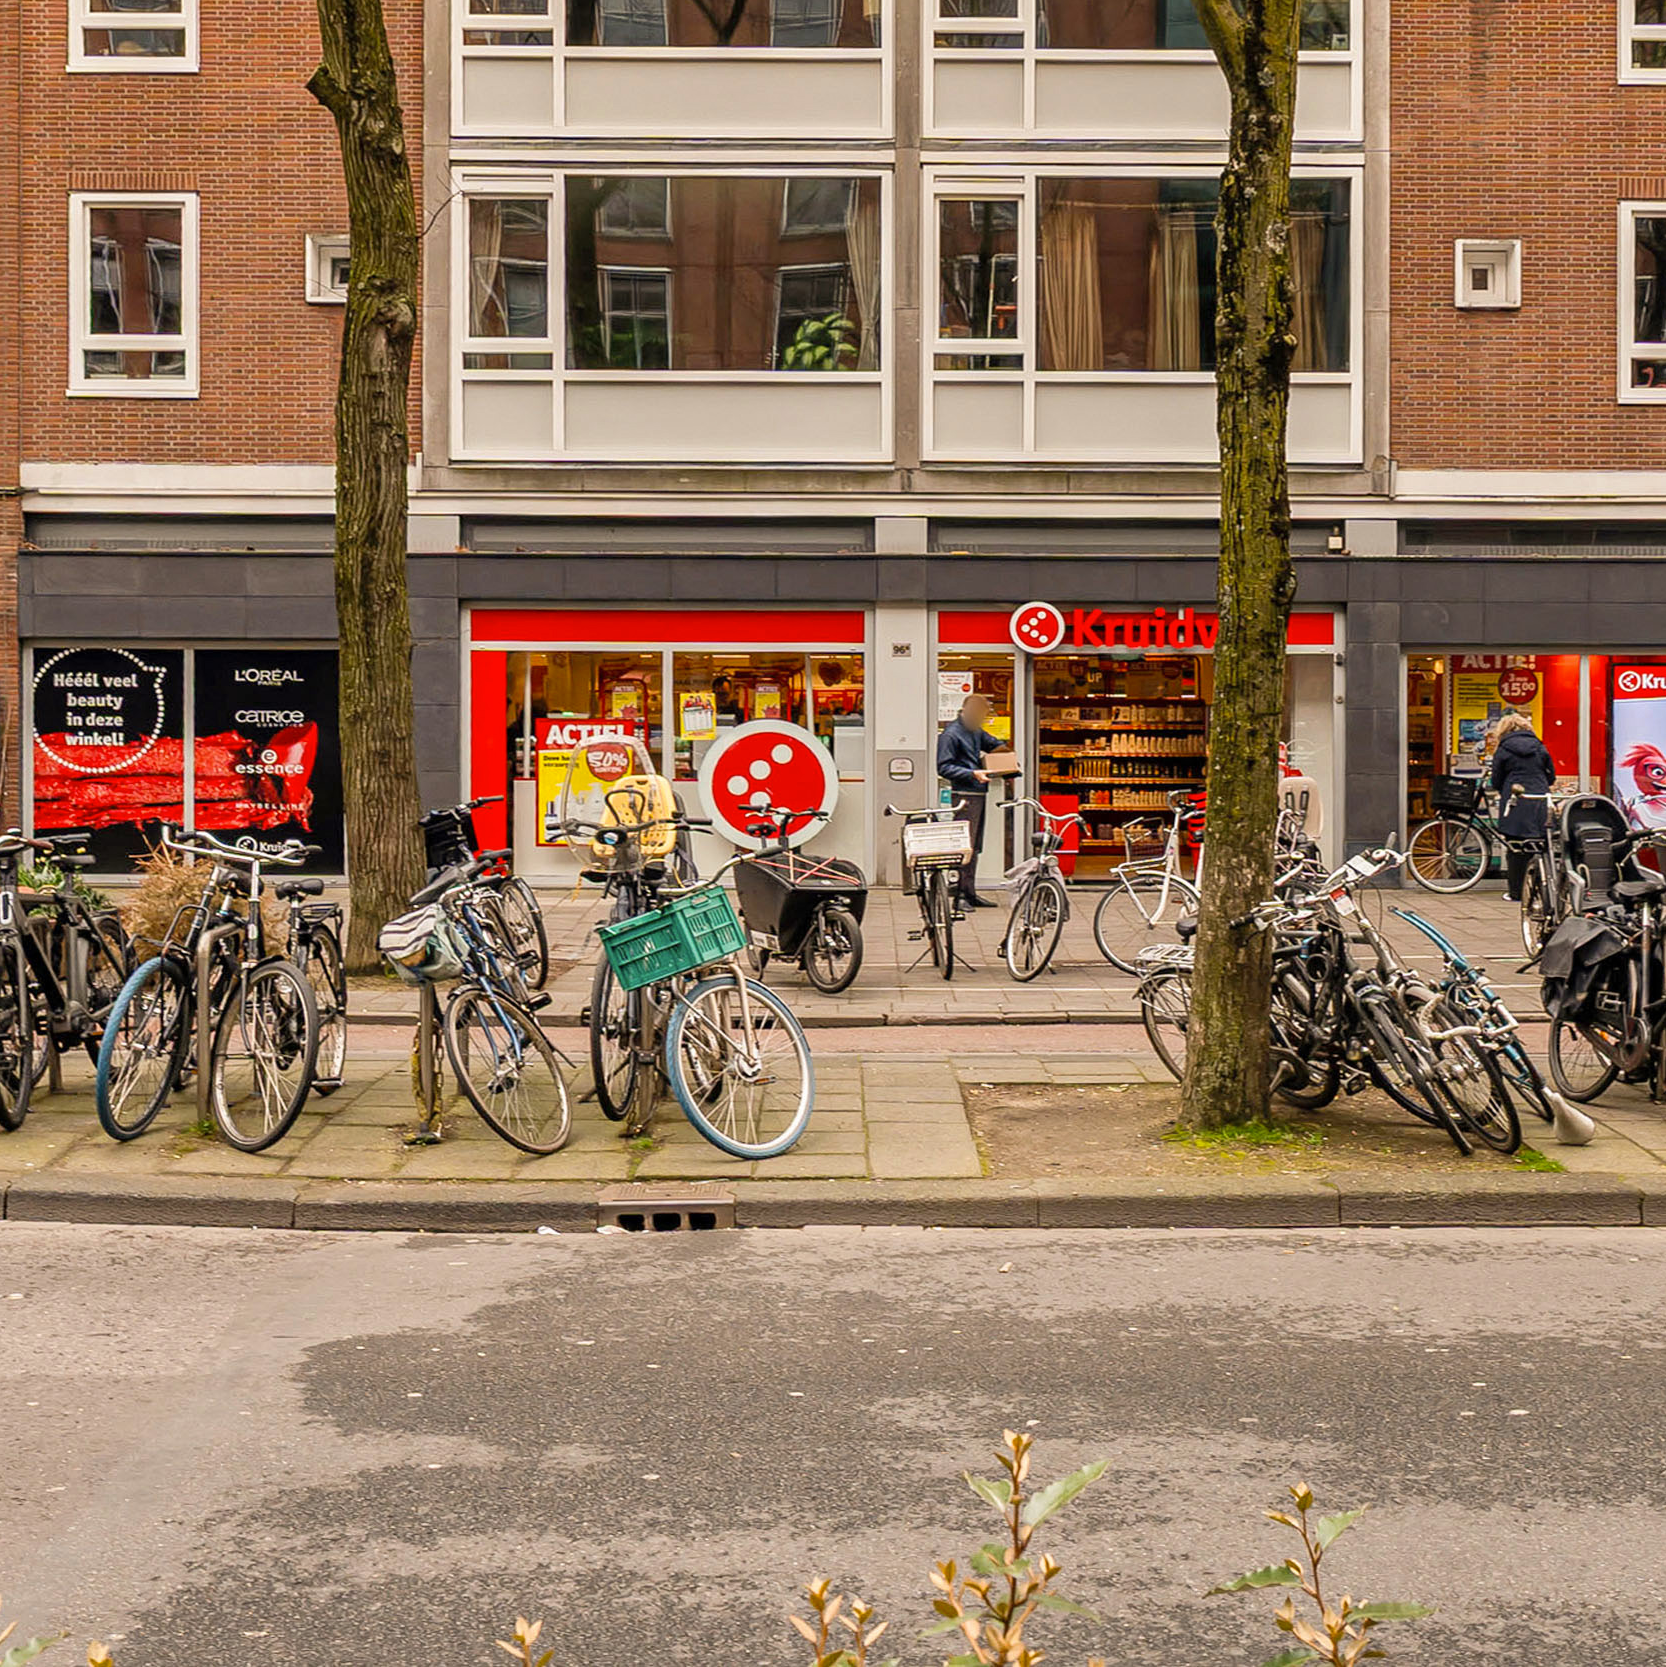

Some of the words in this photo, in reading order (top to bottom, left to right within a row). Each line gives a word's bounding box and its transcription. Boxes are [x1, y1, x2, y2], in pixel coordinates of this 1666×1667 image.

[1073, 607, 1219, 649] Kruidv
[53, 672, 100, 687] Hééél
[102, 673, 139, 687] veel
[66, 692, 124, 710] beauty
[65, 711, 83, 727] in
[85, 712, 124, 727] deze
[64, 731, 125, 746] winkel!
[587, 751, 628, 768] 50%
[235, 764, 305, 774] essence
